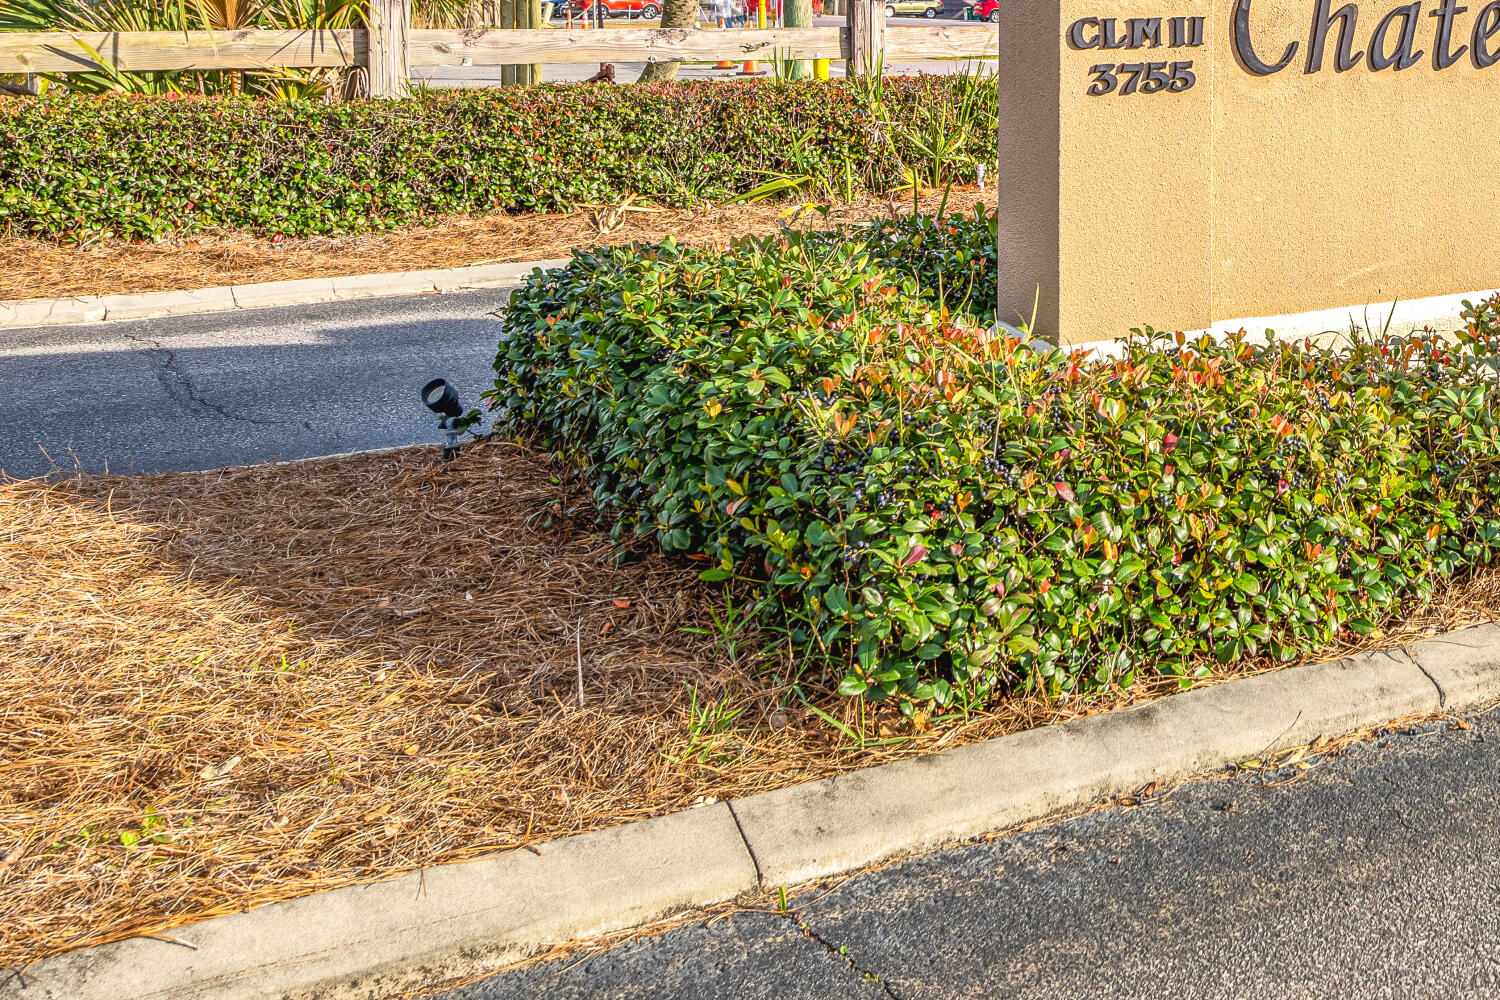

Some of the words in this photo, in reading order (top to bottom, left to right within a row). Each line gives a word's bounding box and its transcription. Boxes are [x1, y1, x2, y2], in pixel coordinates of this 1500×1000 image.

[1066, 16, 1163, 50] CLM
[1167, 16, 1206, 48] II
[1087, 61, 1196, 96] 3755
